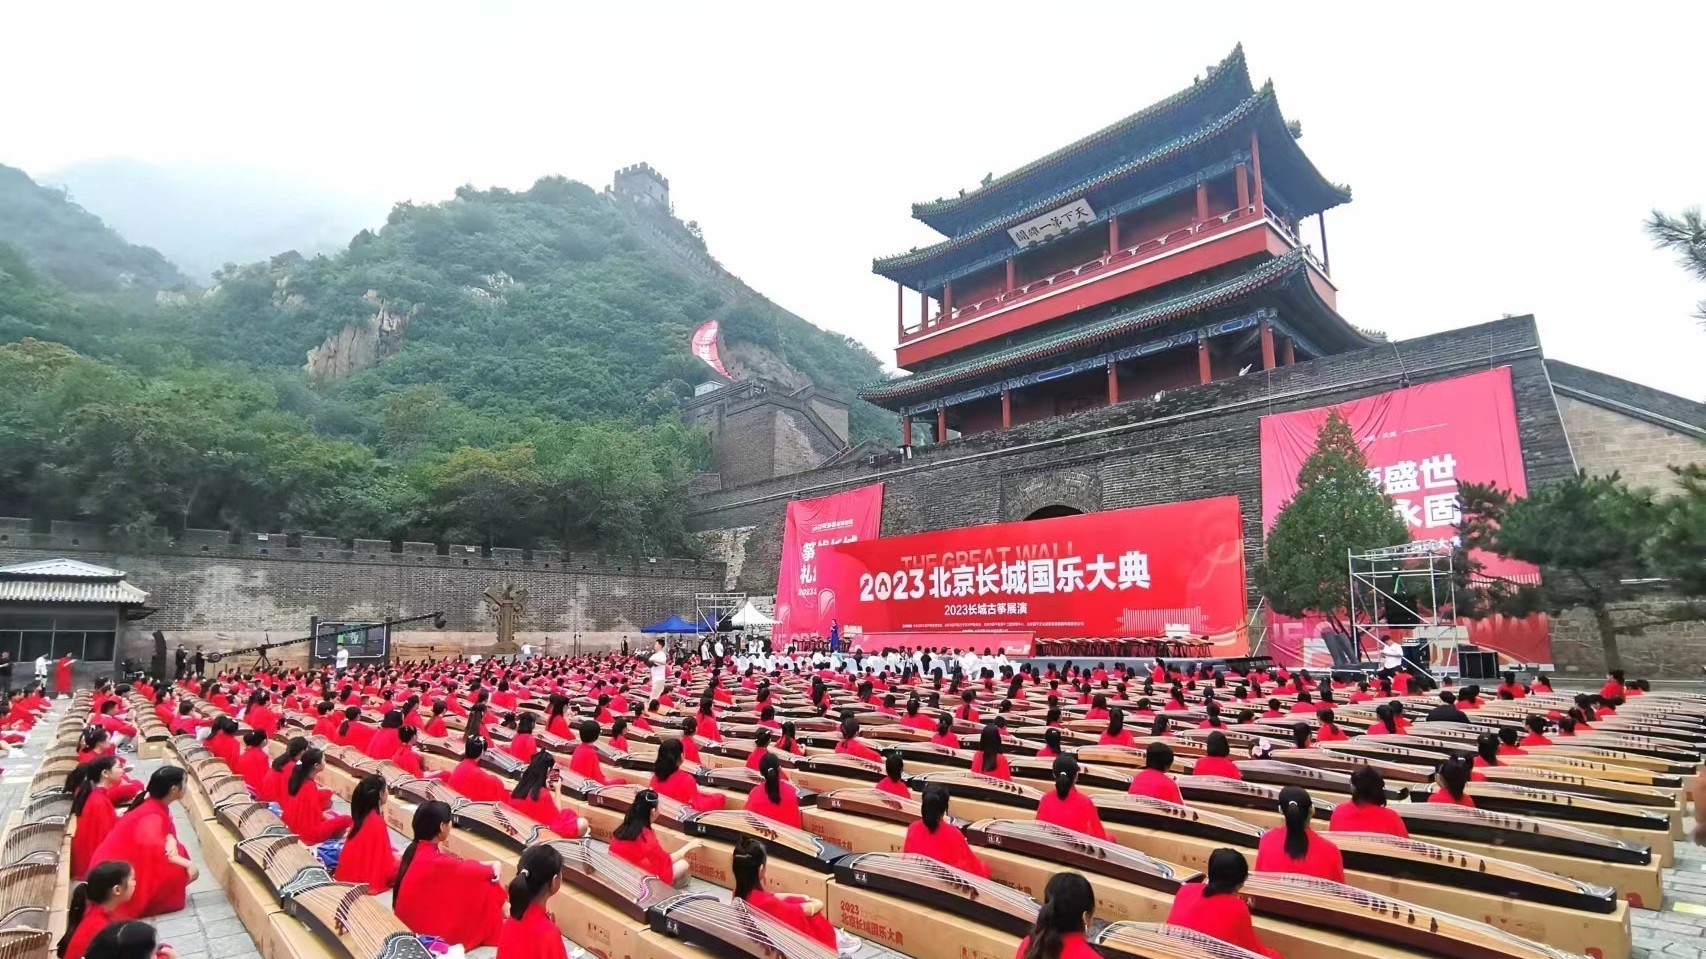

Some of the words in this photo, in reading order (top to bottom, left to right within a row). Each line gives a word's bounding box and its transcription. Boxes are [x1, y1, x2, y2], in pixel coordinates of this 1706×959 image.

[859, 550, 1151, 602] 2023北京长城国乐大典
[944, 602, 1028, 616] 2023长城古筝展演
[840, 900, 860, 915] 2023
[841, 912, 904, 946] 北京长城国乐大典
